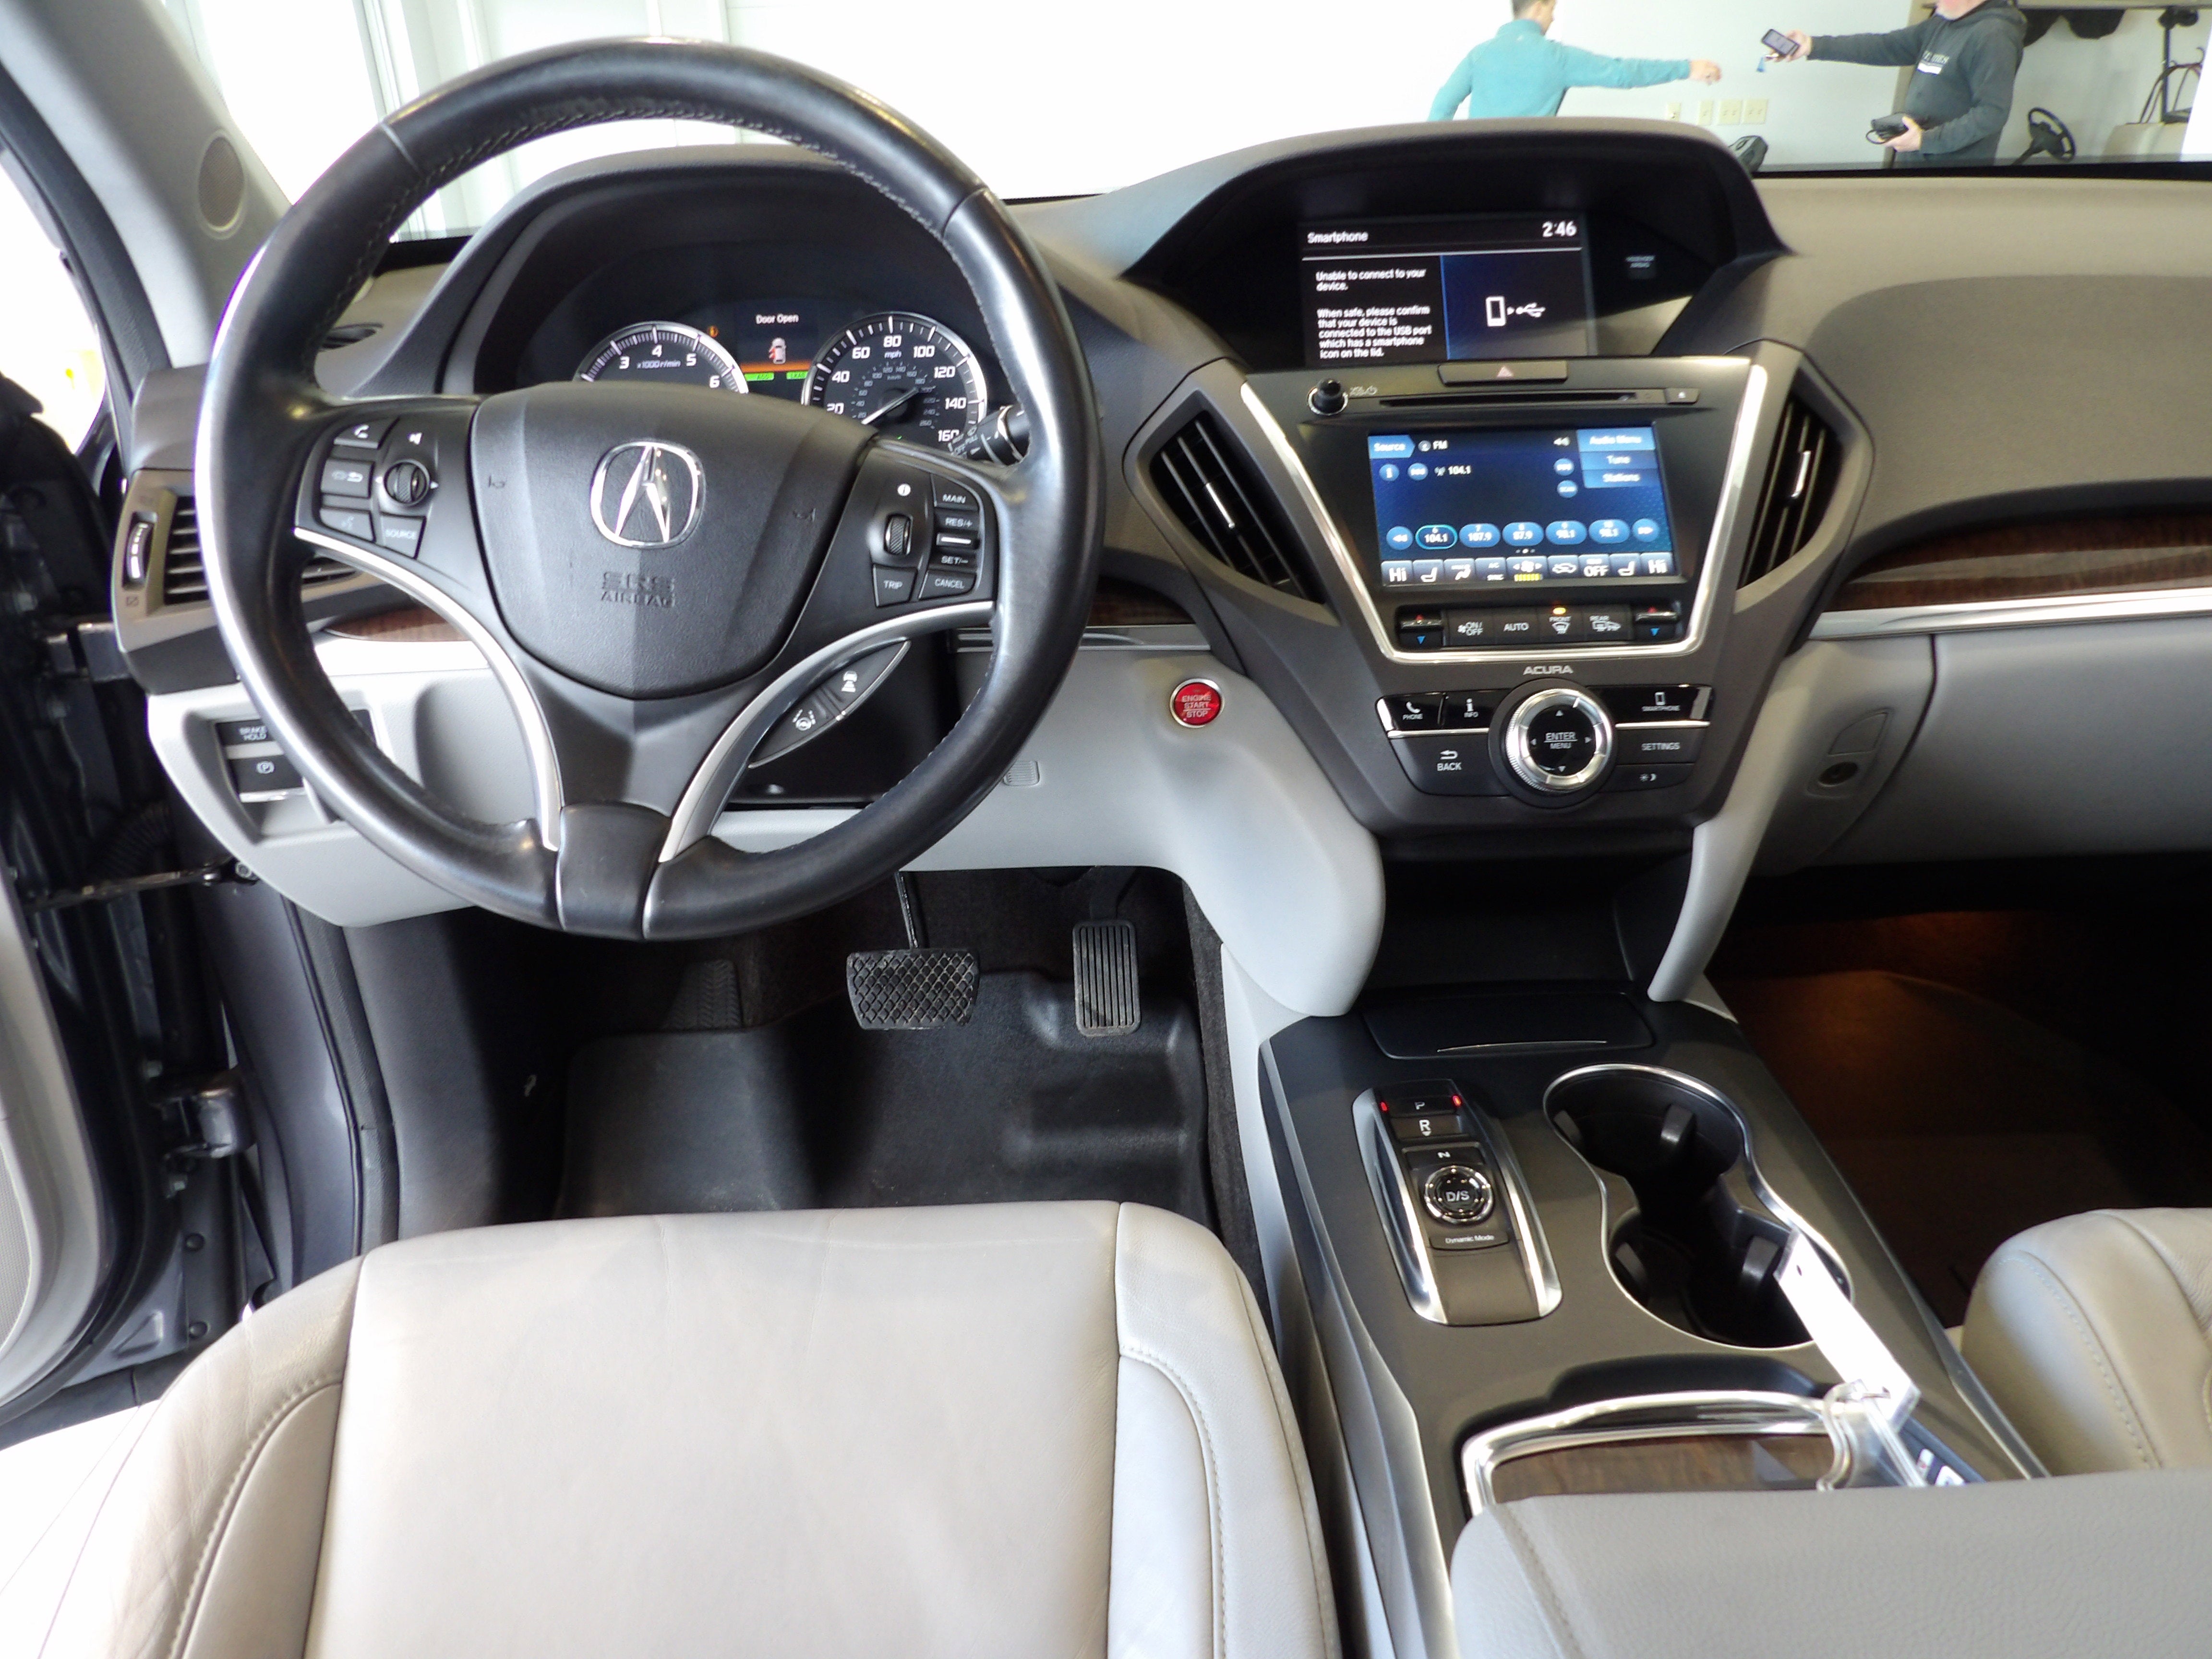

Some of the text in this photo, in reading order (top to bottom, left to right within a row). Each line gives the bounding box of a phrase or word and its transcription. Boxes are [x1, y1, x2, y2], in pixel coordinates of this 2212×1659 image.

[1542, 221, 1577, 238] 2:46
[1308, 231, 1369, 243] Smartphone
[1316, 269, 1427, 281] Unable to connect to your
[1316, 282, 1348, 291] device.
[1317, 305, 1430, 318] When safe, please confirm
[756, 313, 799, 324] Door Open
[1318, 317, 1398, 328] that your device is
[1319, 325, 1432, 338] connected to the USB port
[883, 335, 902, 348] 80
[1319, 337, 1346, 348] which
[1347, 338, 1364, 348] has
[1372, 337, 1425, 347] smartphone
[651, 345, 662, 357] 4
[852, 346, 870, 359] 60
[884, 350, 902, 360] mph
[913, 345, 935, 358] 100
[1320, 348, 1384, 359] icon on the lid.
[619, 356, 630, 369] 3
[686, 353, 697, 366] 5
[831, 371, 850, 384] 40
[934, 366, 956, 379] 120
[709, 375, 720, 388] 6
[945, 397, 967, 410] 140
[1374, 443, 1406, 452] Source
[1432, 440, 1448, 450] FM
[1606, 455, 1631, 464] Tune
[1448, 465, 1472, 475] 104.1
[1602, 473, 1641, 482] Stations
[943, 494, 966, 504] MAIN
[1424, 533, 1448, 543] 104.1
[1584, 565, 1609, 577] OFF
[1648, 559, 1668, 574] Hi
[1389, 567, 1407, 582] Hi
[602, 572, 674, 592] SRS
[883, 580, 903, 589] TRIP
[935, 578, 965, 589] CANCEL
[1466, 628, 1483, 636] OFF
[1503, 622, 1529, 632] AUTO
[1523, 665, 1574, 675] ACURA
[1181, 694, 1212, 702] ENGINE
[1546, 732, 1576, 741] ENTER
[1641, 742, 1680, 751] SETTINGS
[1437, 762, 1462, 771] BACK
[1415, 1102, 1425, 1110] P
[1419, 1119, 1431, 1131] R
[1445, 1190, 1470, 1202] D/S
[1445, 1233, 1495, 1244] Dynamic Mode
